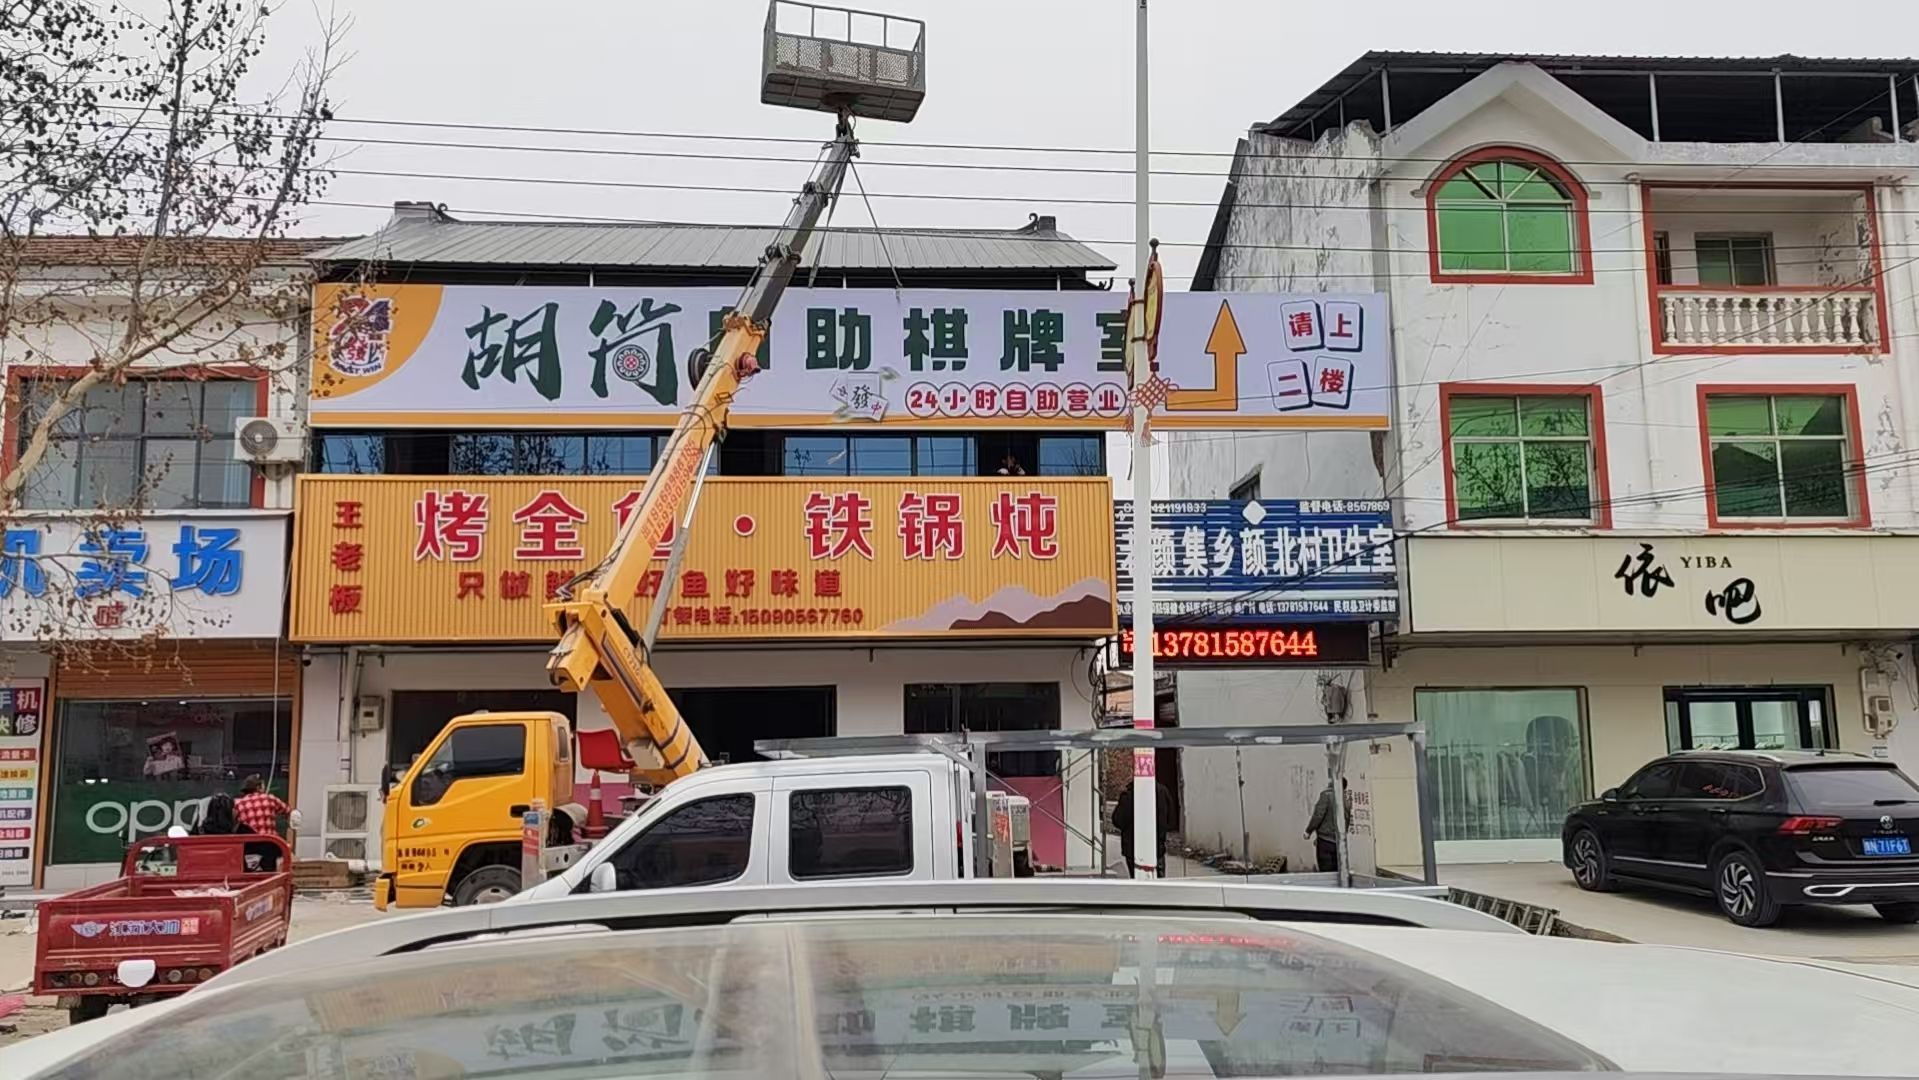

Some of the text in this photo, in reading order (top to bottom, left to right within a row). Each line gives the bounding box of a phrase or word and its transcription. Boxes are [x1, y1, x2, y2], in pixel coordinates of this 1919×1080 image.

[1288, 313, 1354, 340] 请上
[1278, 367, 1346, 397] 二楼
[909, 389, 1119, 412] 24小时自助营业
[329, 501, 364, 615] 王老板
[1680, 556, 1732, 568] YIBA
